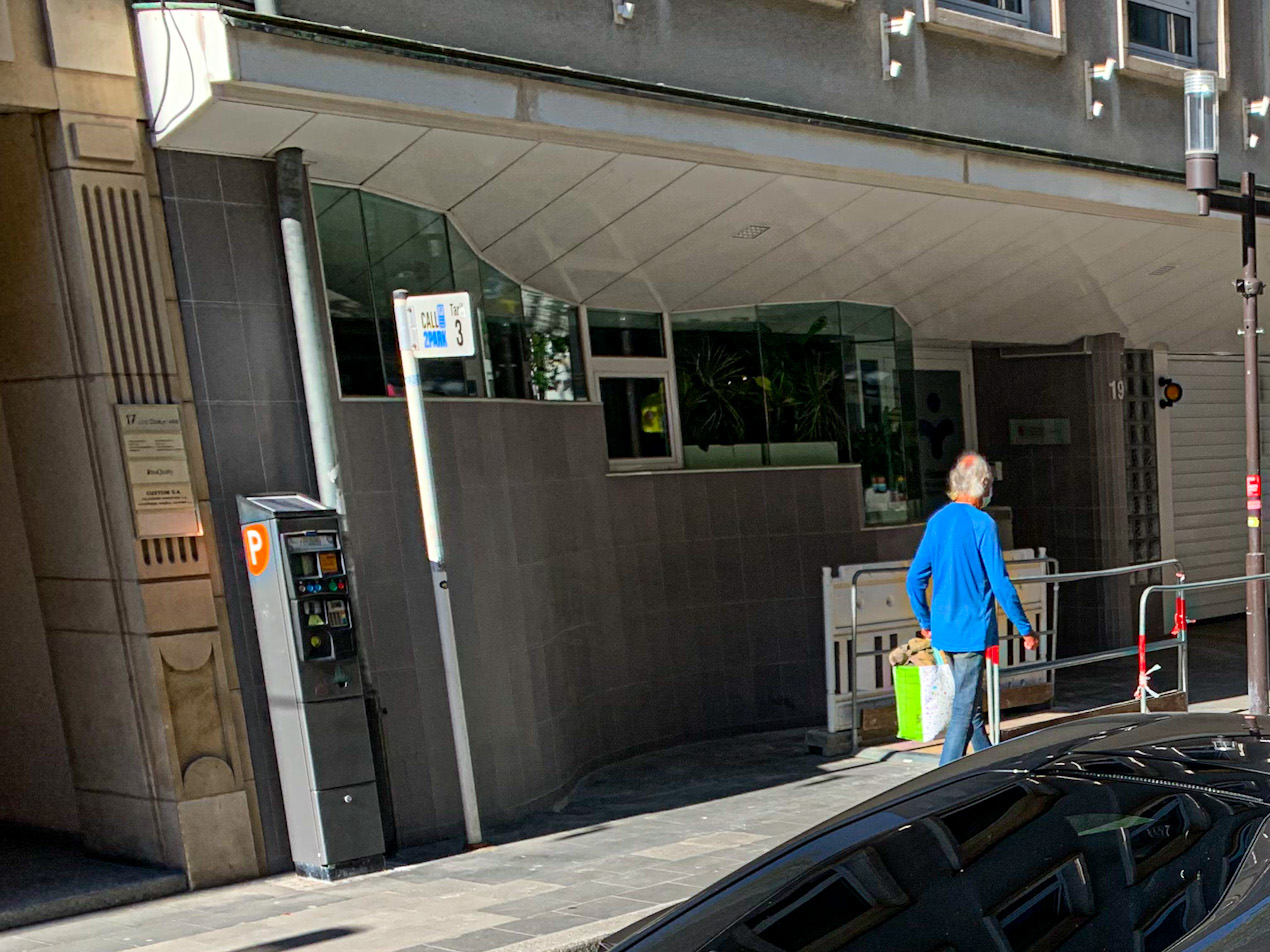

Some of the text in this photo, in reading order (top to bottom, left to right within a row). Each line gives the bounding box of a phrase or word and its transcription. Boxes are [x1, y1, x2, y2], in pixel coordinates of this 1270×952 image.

[421, 311, 439, 329] CALL
[423, 330, 448, 348] 2PARK
[455, 319, 464, 346] 3
[1109, 380, 1125, 400] 19
[126, 414, 136, 425] 17
[246, 529, 263, 566] P
